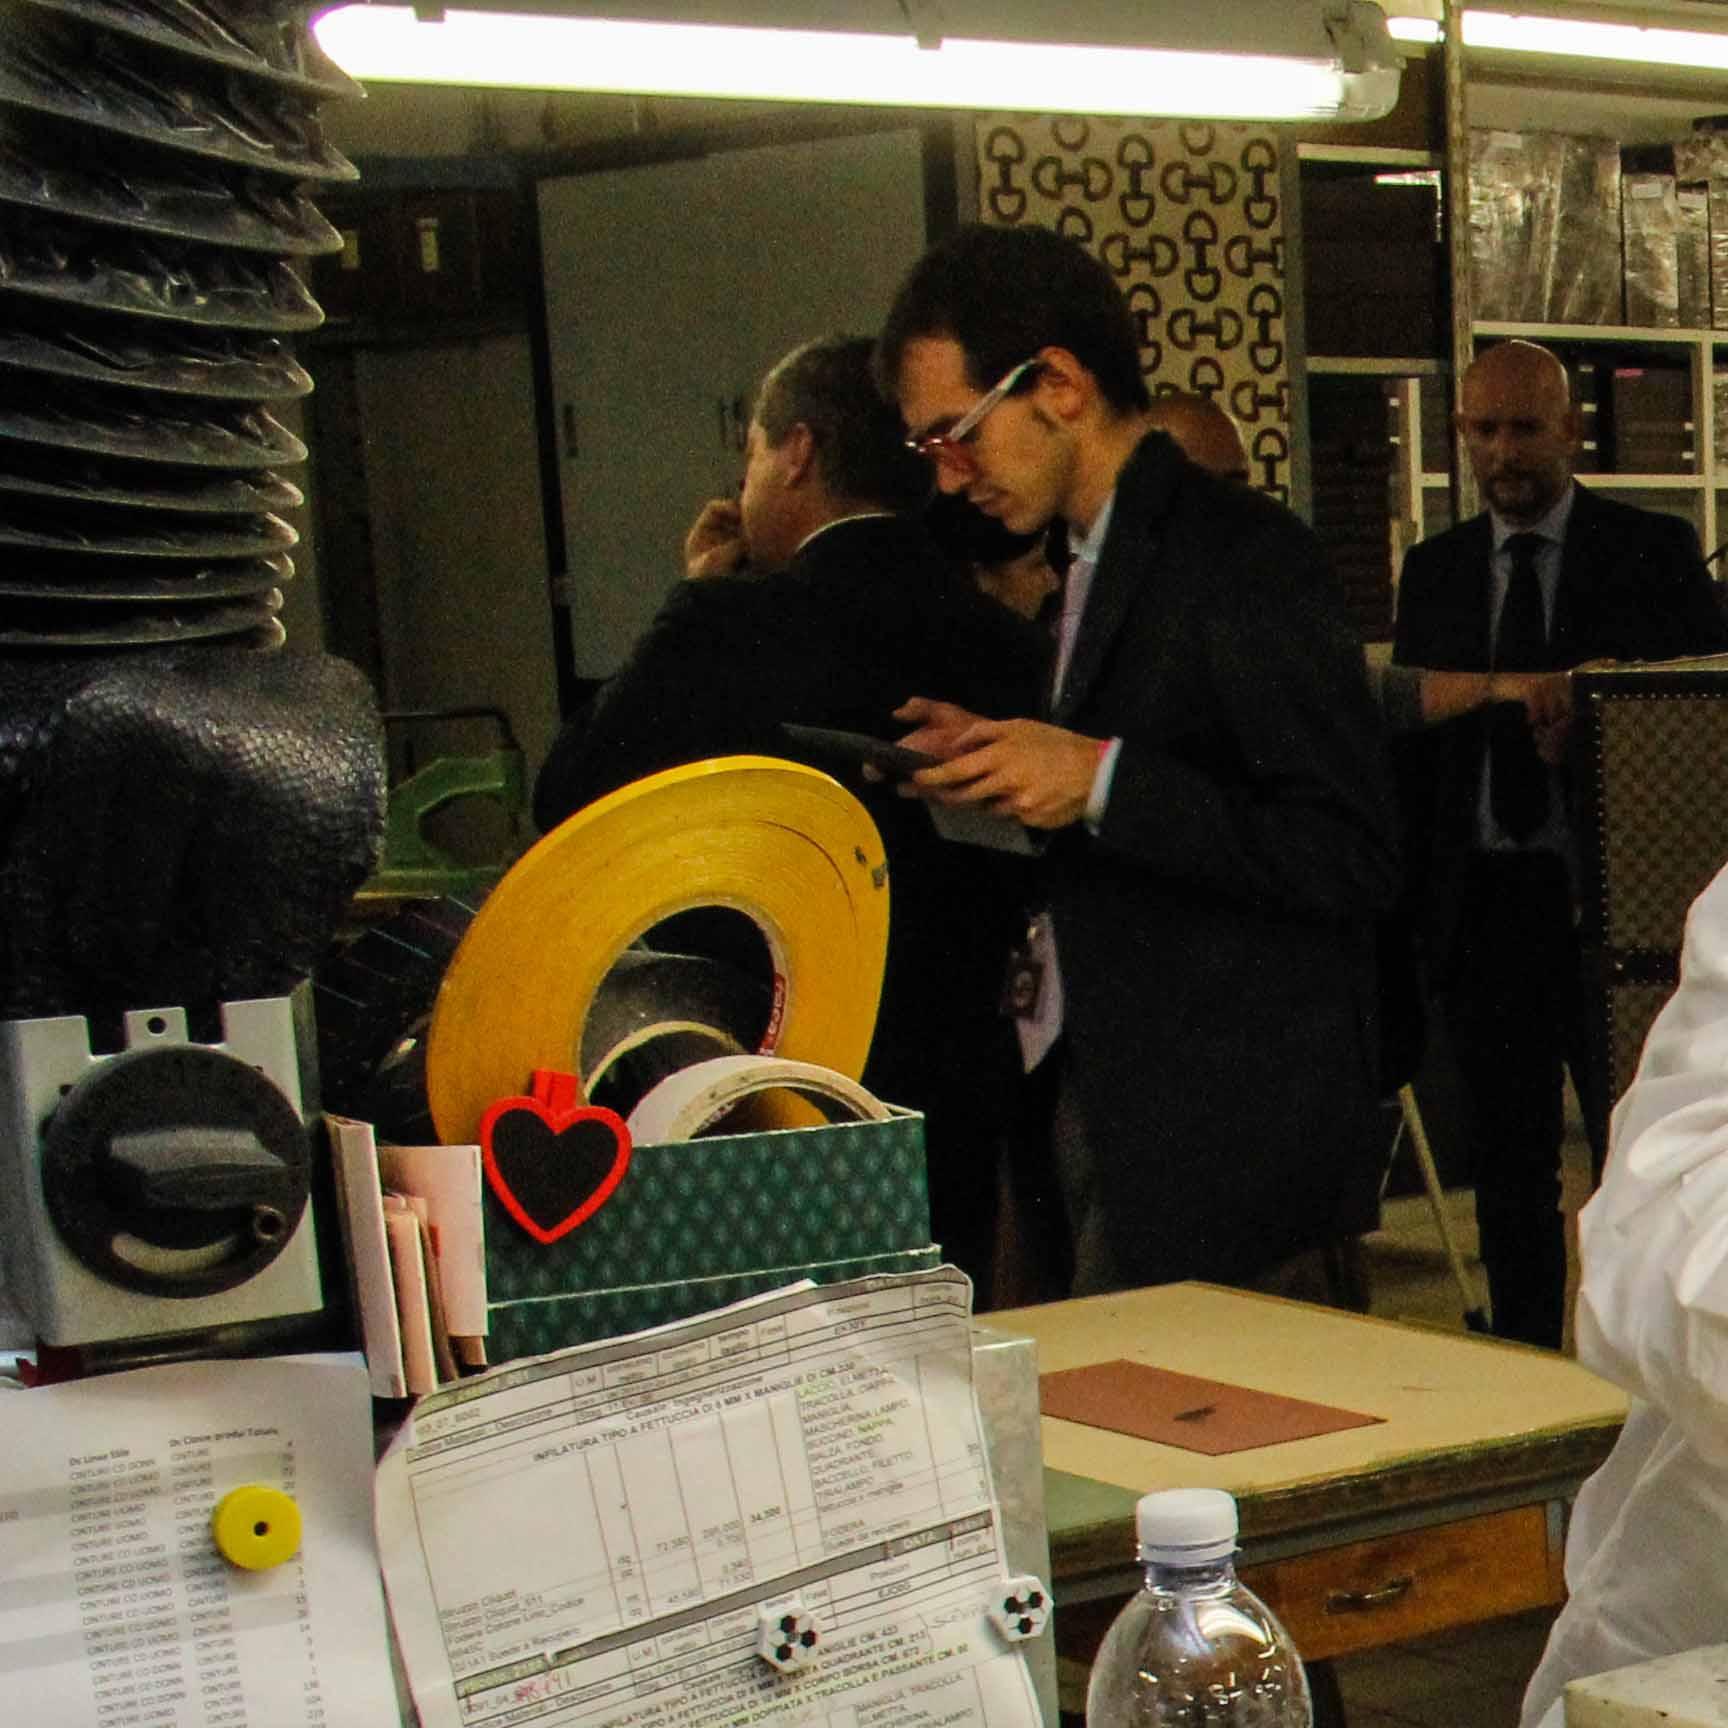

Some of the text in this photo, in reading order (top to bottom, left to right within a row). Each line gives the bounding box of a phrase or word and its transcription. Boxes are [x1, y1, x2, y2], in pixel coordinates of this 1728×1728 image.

[532, 1434, 601, 1462] INFILATURA
[600, 1426, 628, 1442] TIPO
[639, 1407, 700, 1431] FETTUCCIA
[662, 1694, 689, 1710] TIPO
[697, 1670, 757, 1698] FETTUCCIA
[674, 1692, 736, 1720] FETTUCCIA
[820, 1641, 888, 1670] QUADRANTE
[730, 1715, 750, 1728] MM
[749, 1696, 805, 1722] DOPPIATA
[813, 1675, 867, 1699] TRACOLLA
[879, 1653, 937, 1678] PASSANTE
[802, 1669, 842, 1689] CORPO
[841, 1659, 879, 1678] BORSA
